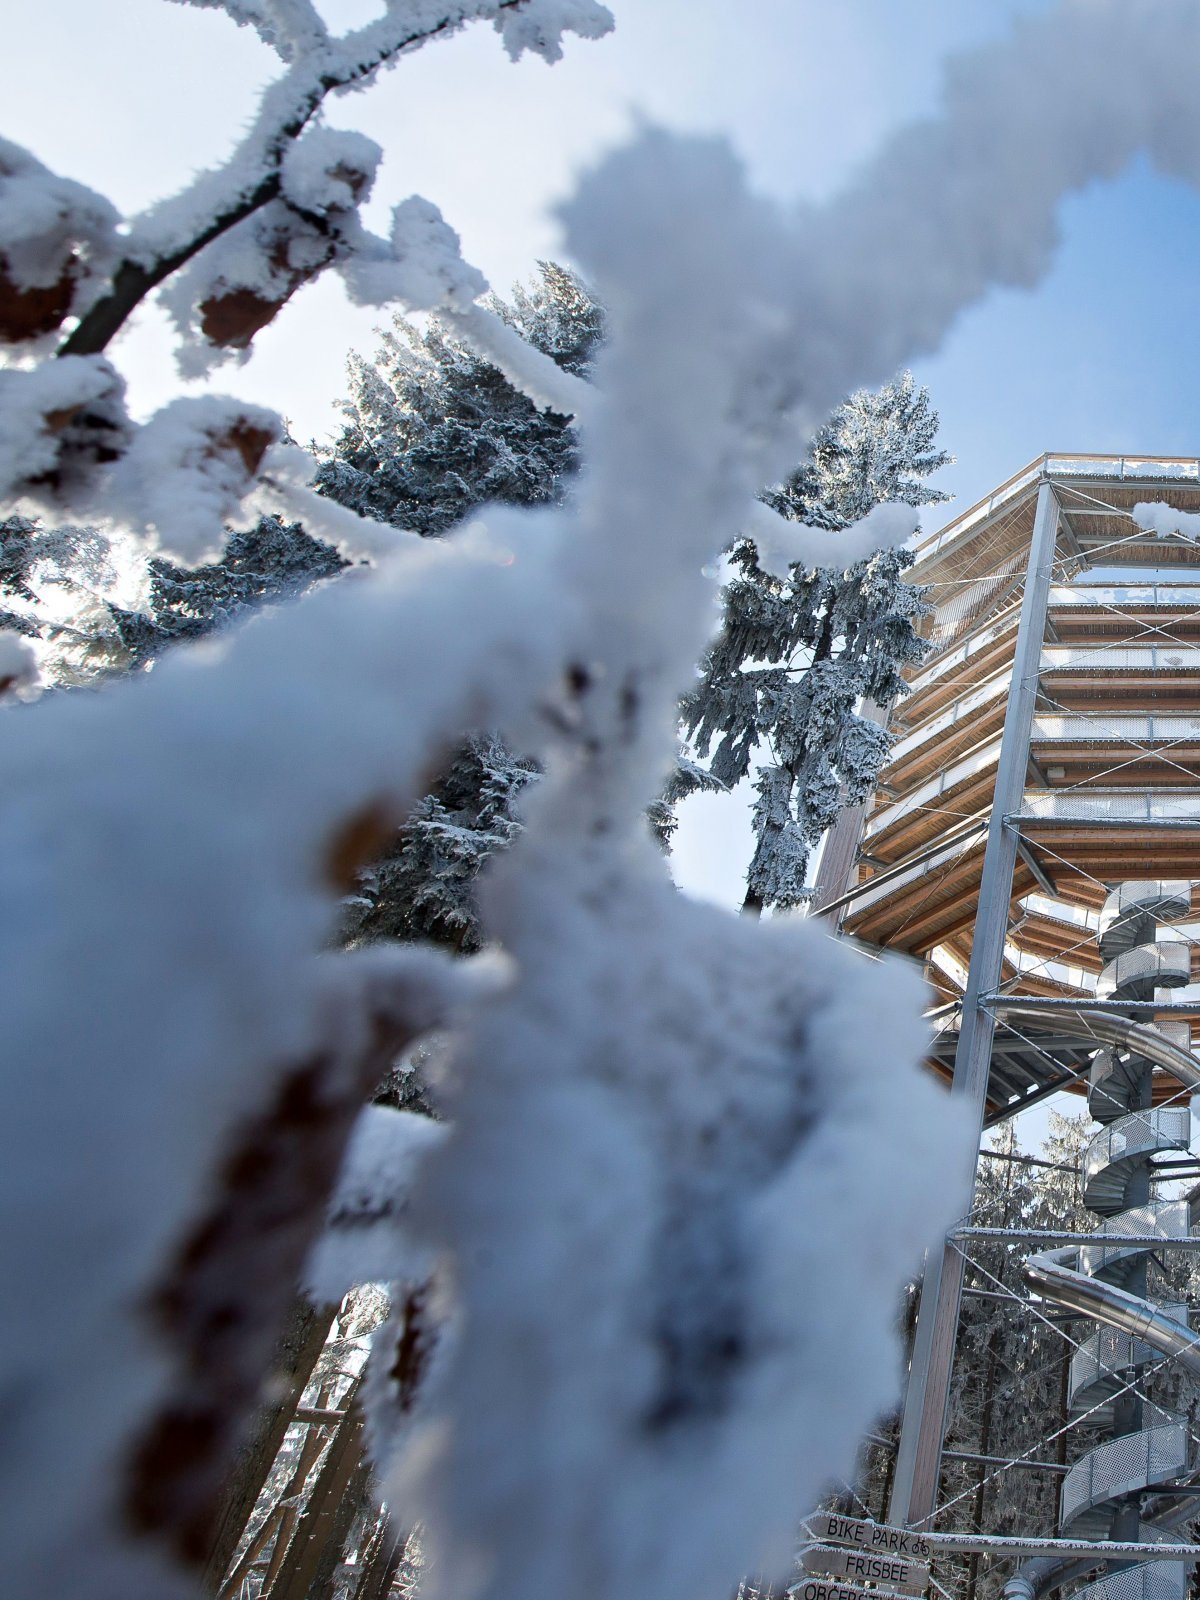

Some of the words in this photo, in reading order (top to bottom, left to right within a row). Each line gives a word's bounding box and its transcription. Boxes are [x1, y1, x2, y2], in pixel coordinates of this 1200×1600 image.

[828, 1518, 865, 1542] BIKE
[872, 1529, 910, 1552] PARK
[845, 1556, 909, 1582] FRISBEE
